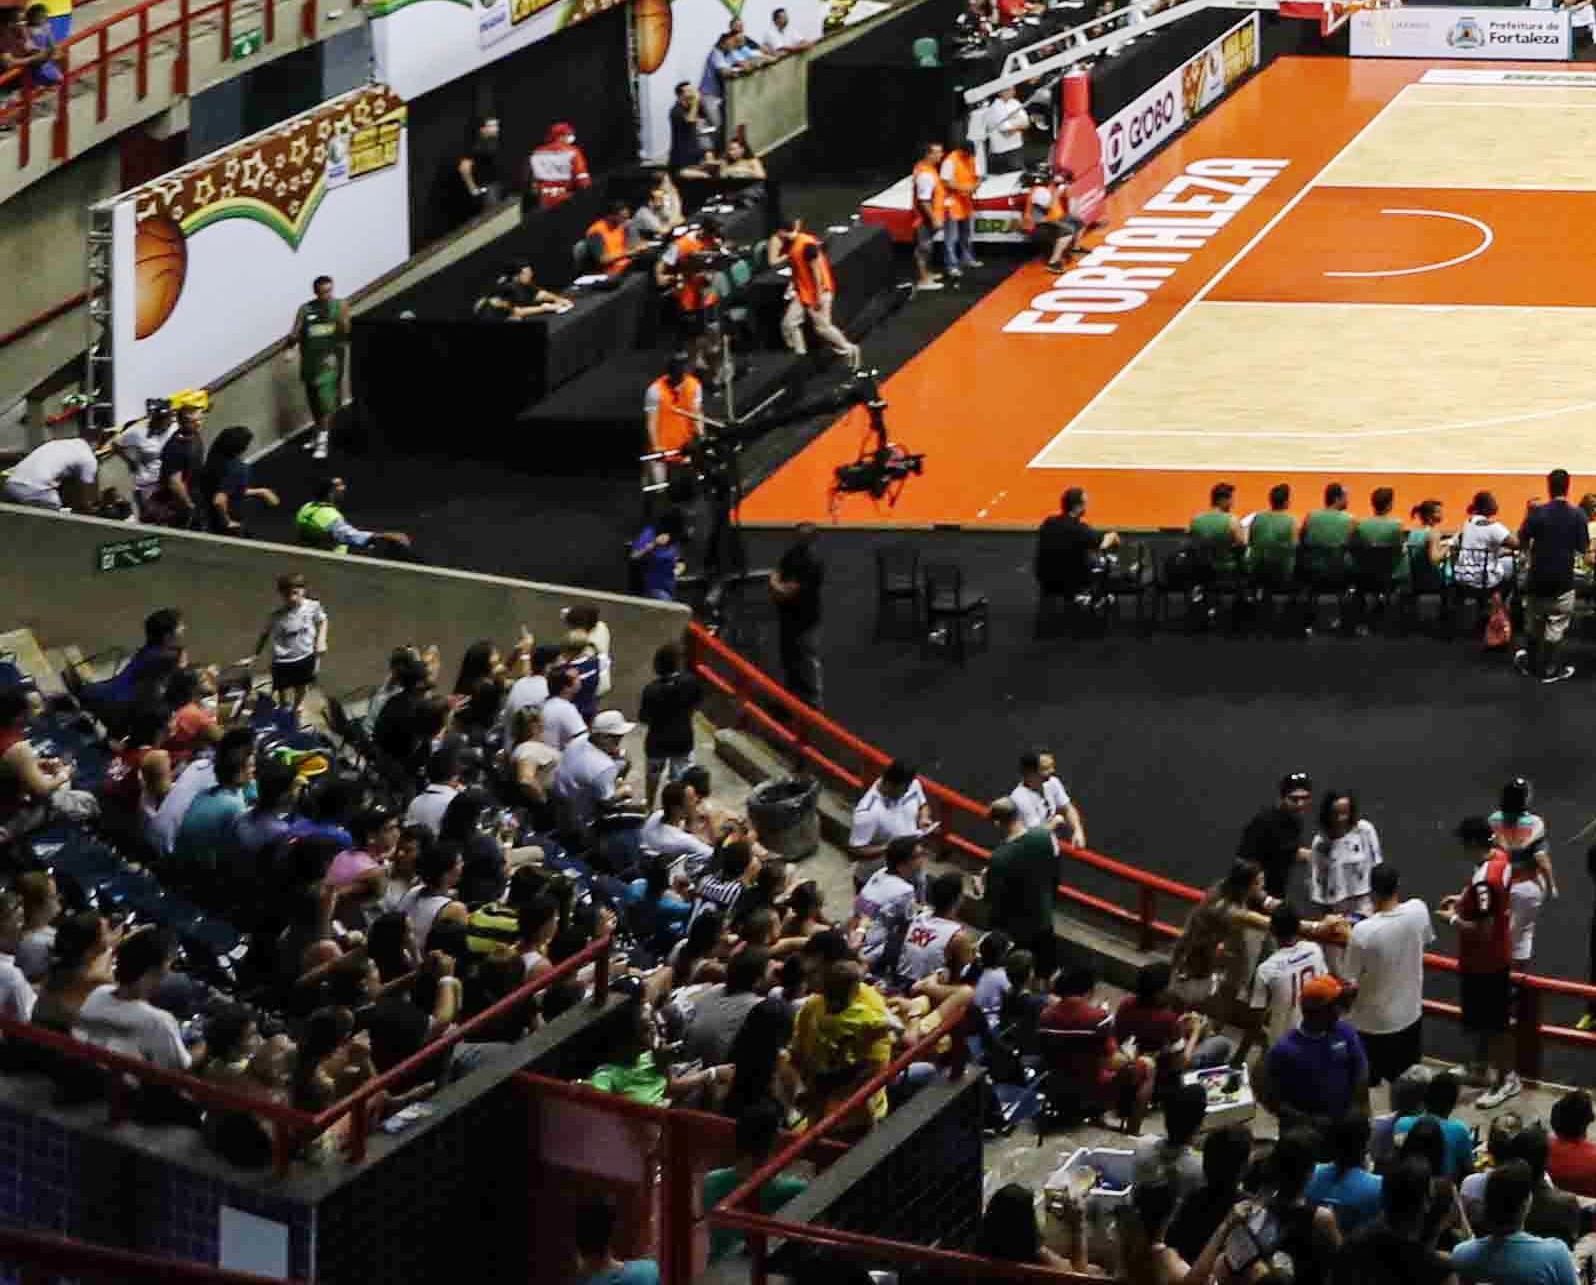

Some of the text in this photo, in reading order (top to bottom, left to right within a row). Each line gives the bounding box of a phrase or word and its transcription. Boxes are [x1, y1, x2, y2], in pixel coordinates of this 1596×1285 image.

[1489, 32, 1560, 46] Fortaleza
[1129, 90, 1175, 150] GLOBO
[1001, 157, 1293, 335] FORTALEZA
